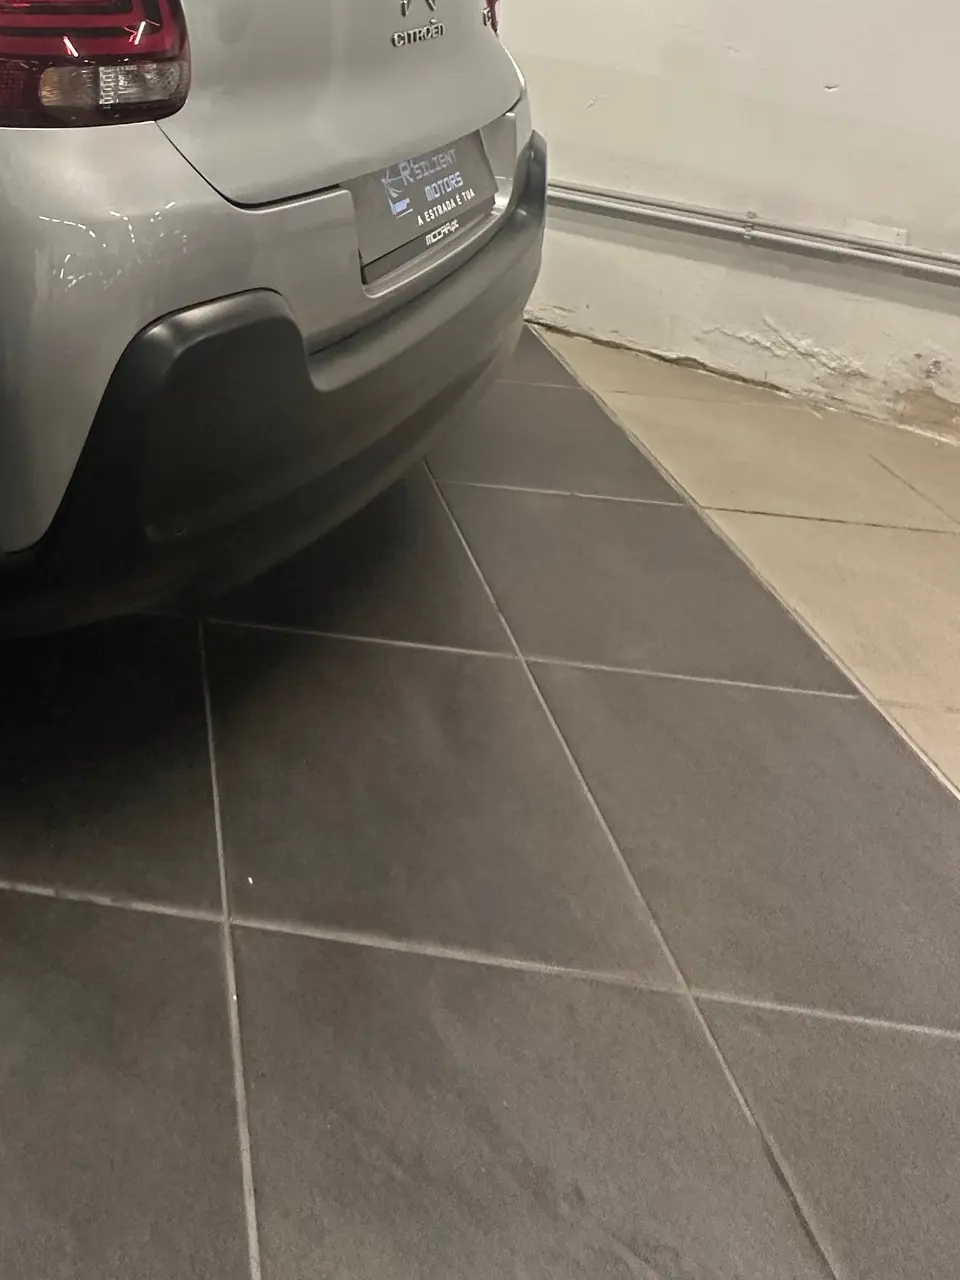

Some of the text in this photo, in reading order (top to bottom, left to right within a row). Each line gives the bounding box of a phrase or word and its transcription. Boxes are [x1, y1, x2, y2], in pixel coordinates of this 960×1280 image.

[424, 171, 464, 202] MOTORS
[417, 215, 424, 226] A
[424, 198, 457, 222] ESTRADA
[461, 188, 476, 202] TUA
